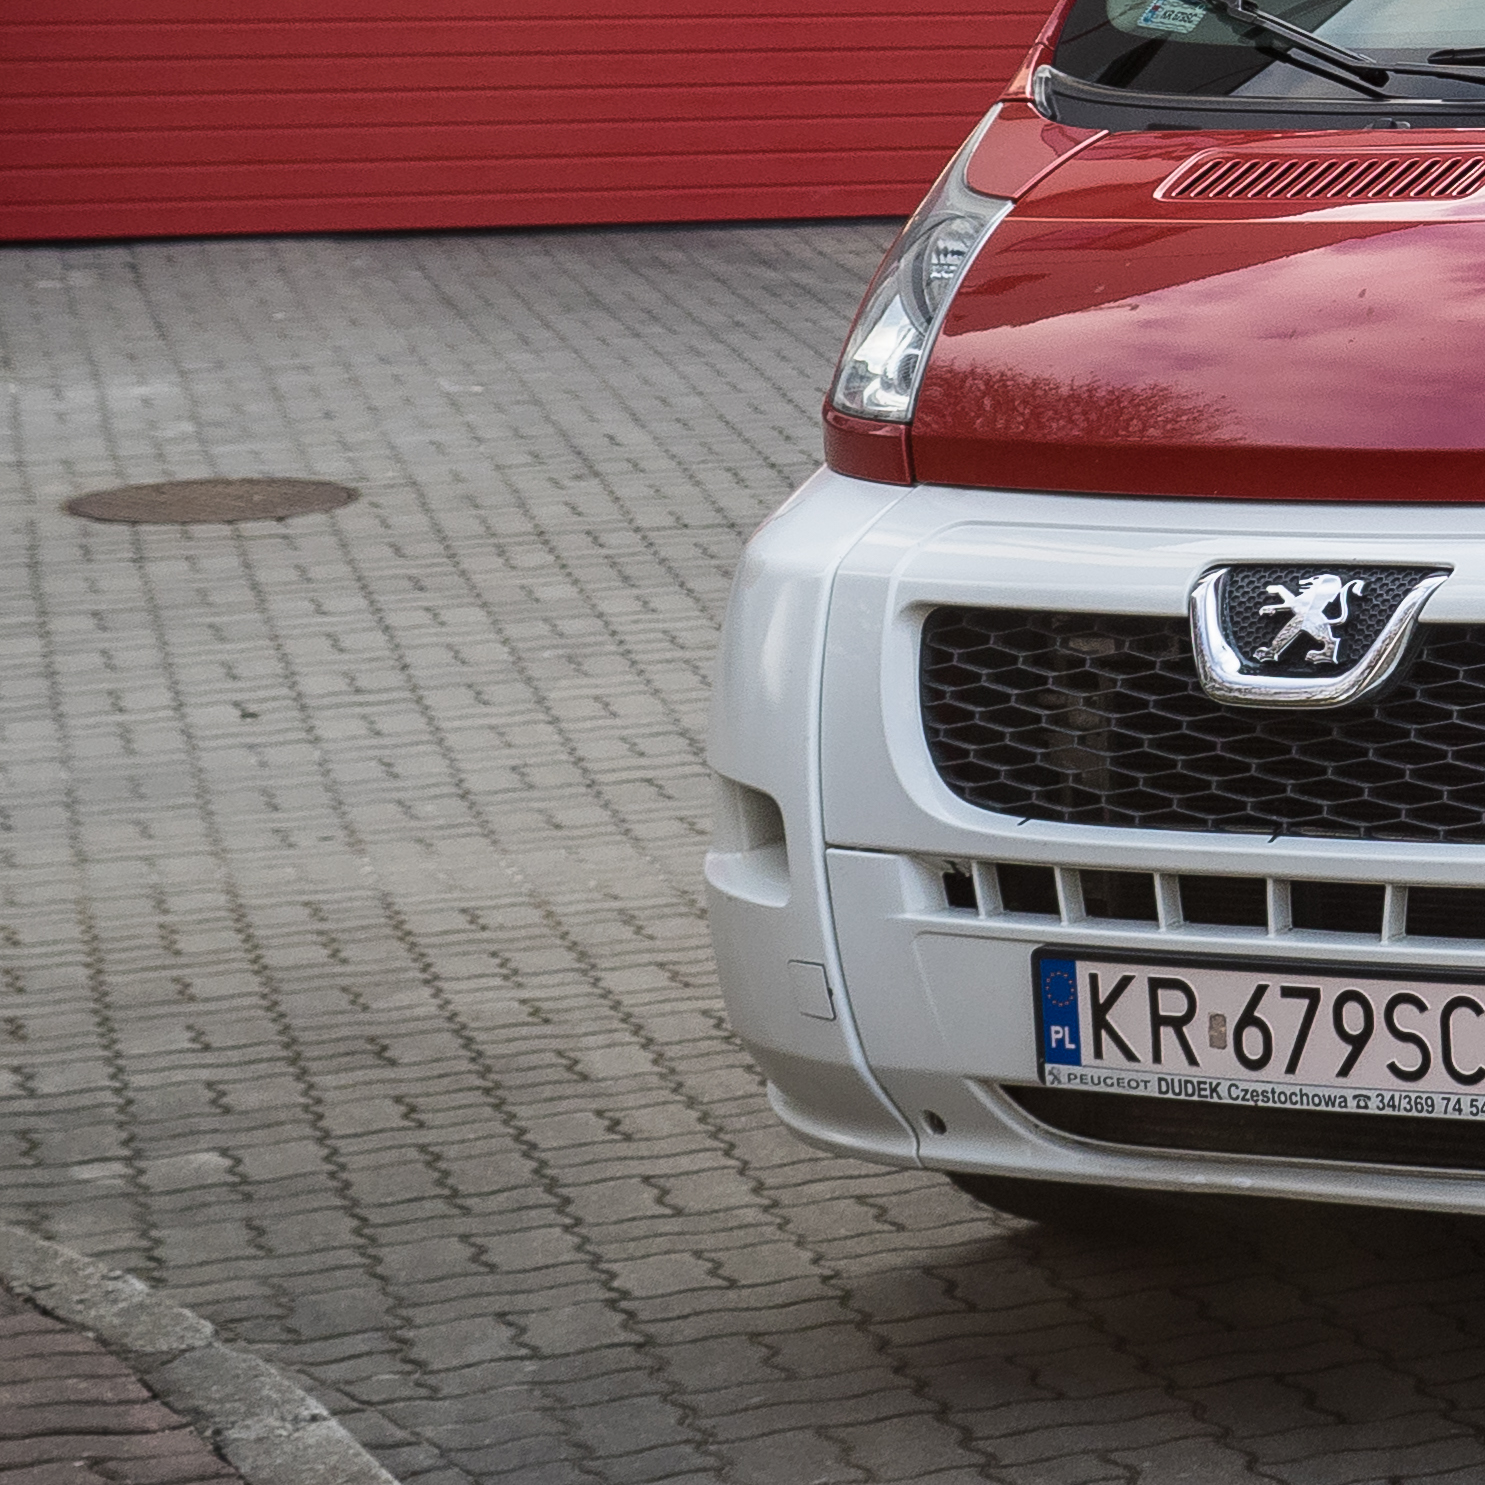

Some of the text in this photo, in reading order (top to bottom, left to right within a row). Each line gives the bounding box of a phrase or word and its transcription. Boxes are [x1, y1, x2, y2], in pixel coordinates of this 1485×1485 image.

[1051, 1025, 1076, 1050] PL
[1089, 972, 1201, 1068] KR
[1067, 1072, 1152, 1091] PEUGEOT
[1157, 1077, 1223, 1102] DUDEK
[1227, 1084, 1348, 1110] Częstochowa
[1375, 1092, 1436, 1115] 34/369
[1441, 1097, 1464, 1116] 74
